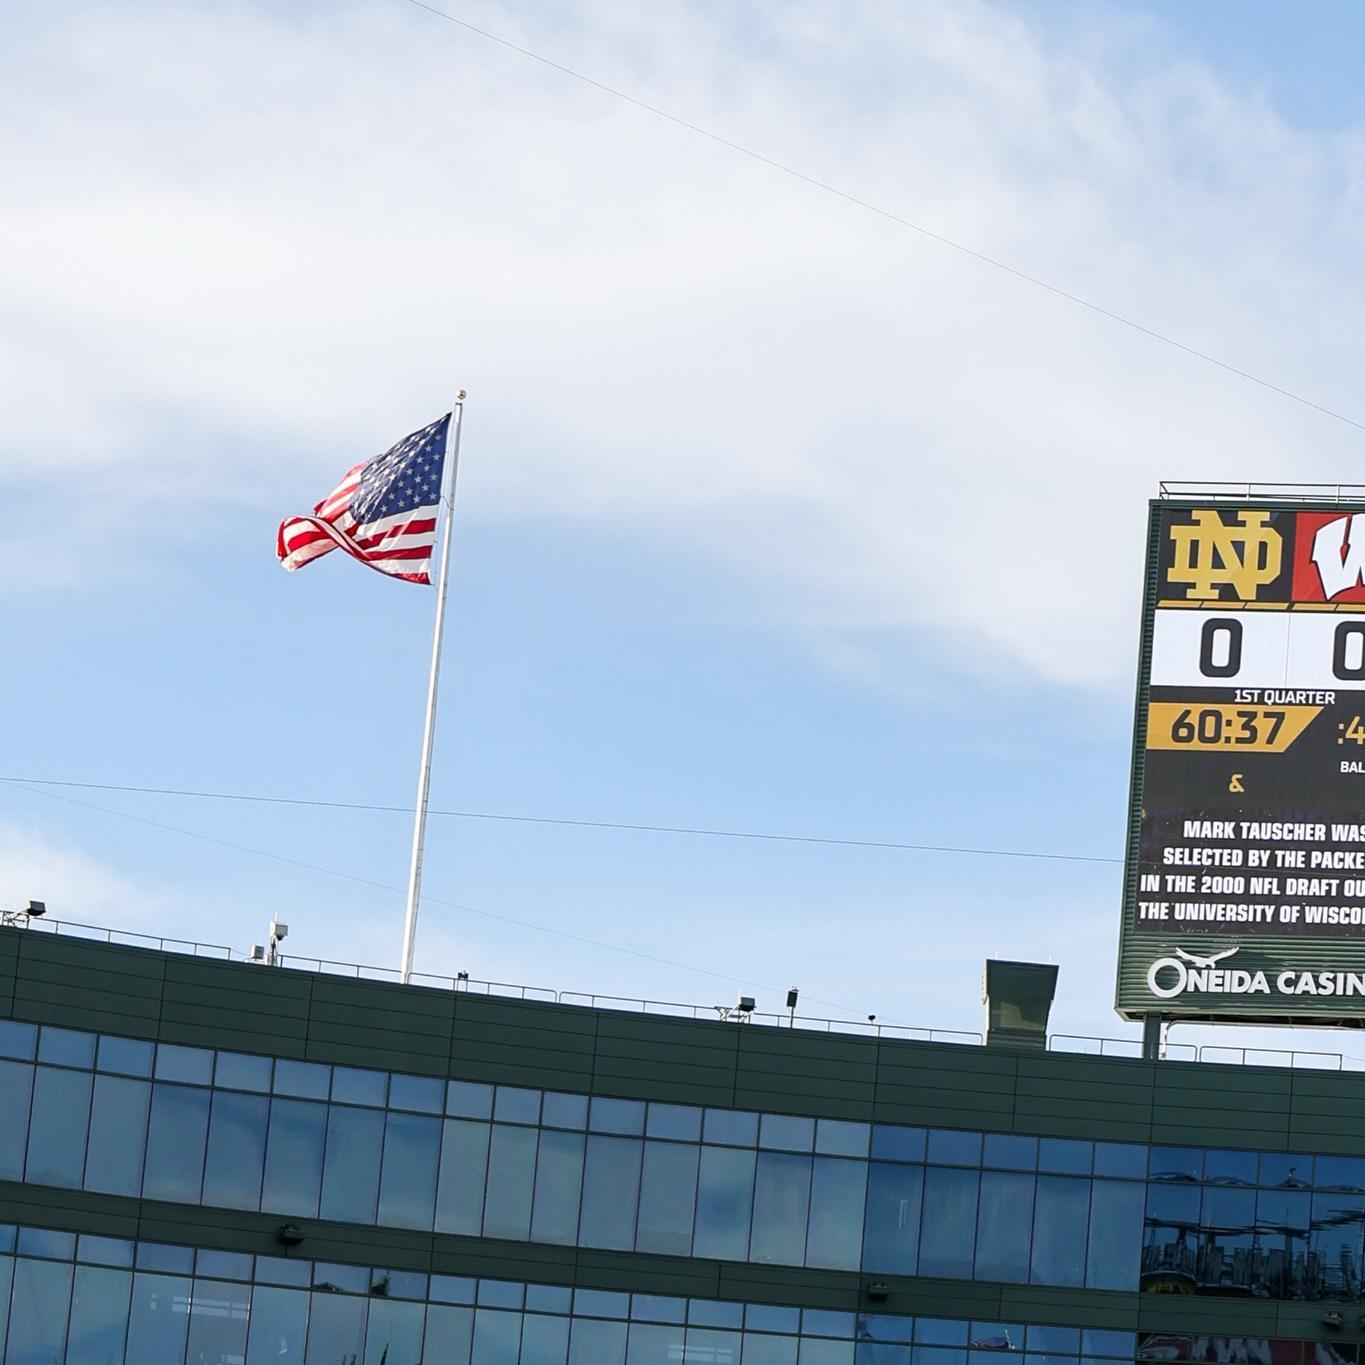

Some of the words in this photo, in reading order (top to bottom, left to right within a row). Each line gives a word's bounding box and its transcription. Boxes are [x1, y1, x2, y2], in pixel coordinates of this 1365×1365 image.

[1200, 617, 1243, 678] 0
[1234, 689, 1262, 703] 1ST
[1264, 689, 1336, 705] QUARTER
[1171, 709, 1286, 744] 60:37
[1228, 773, 1245, 793] &
[1183, 820, 1235, 839] MARK
[1240, 821, 1326, 841] TAUSCHER
[1162, 847, 1243, 867] SELECTED
[1247, 849, 1270, 867] BY
[1275, 850, 1305, 868] THE
[1140, 874, 1159, 893] IN
[1164, 875, 1197, 893] THE
[1201, 876, 1245, 894] 2000
[1249, 877, 1281, 895] NFL
[1286, 878, 1339, 897] DRAFT
[1139, 902, 1169, 920] THE
[1174, 903, 1275, 922] UNIVERSITY
[1279, 906, 1300, 923] OF
